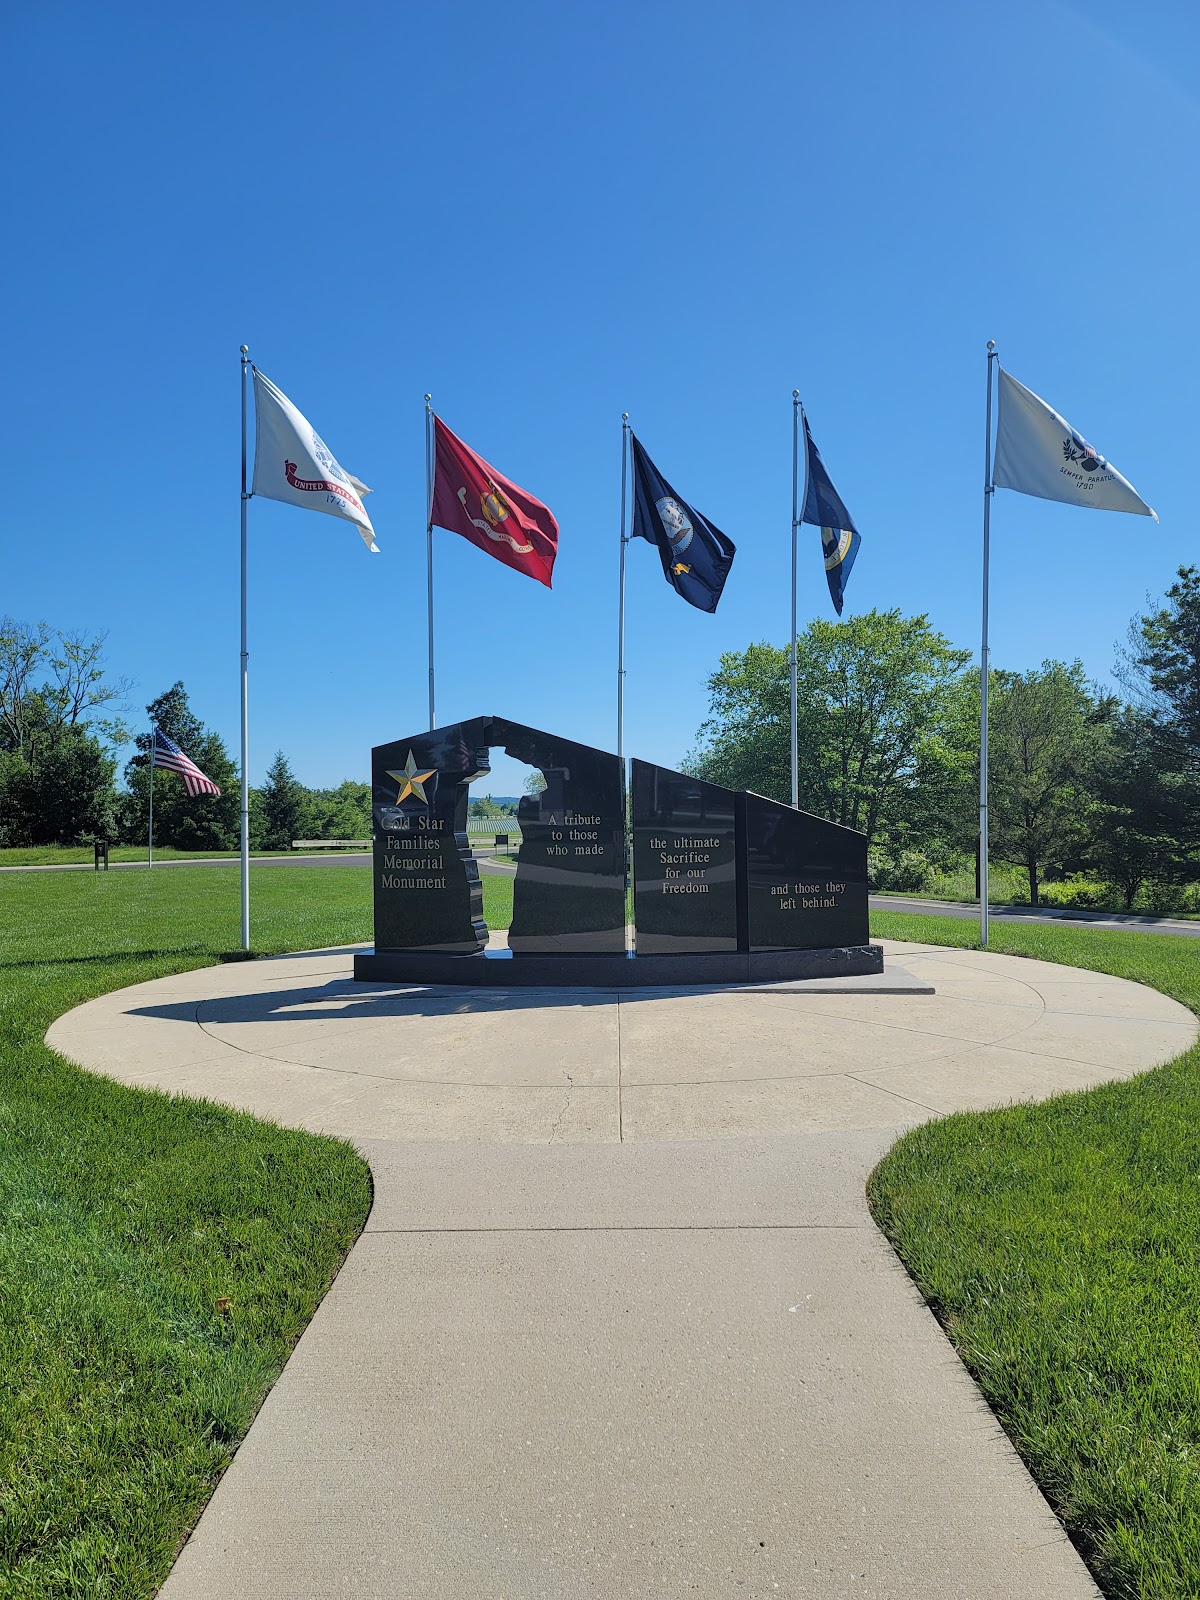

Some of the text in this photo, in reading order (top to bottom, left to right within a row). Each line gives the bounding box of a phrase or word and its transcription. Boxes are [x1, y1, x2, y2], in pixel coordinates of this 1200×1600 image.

[1059, 466, 1116, 483] SEMPER PARATUS
[294, 480, 324, 491] UNITED
[1076, 481, 1094, 490] 1790
[326, 494, 347, 508] 1775
[381, 815, 445, 830] Gold Star
[548, 813, 601, 826] A tribute
[551, 828, 598, 841] to those
[386, 835, 440, 850] Families
[650, 836, 720, 849] the ultimate
[546, 843, 604, 856] who made
[383, 854, 443, 870] Memorial
[660, 851, 710, 864] Sacrifice
[665, 867, 706, 879] for our
[381, 873, 446, 889] Monument
[770, 880, 846, 895] and those they
[662, 882, 709, 894] Freedom
[779, 896, 839, 910] left behind.
